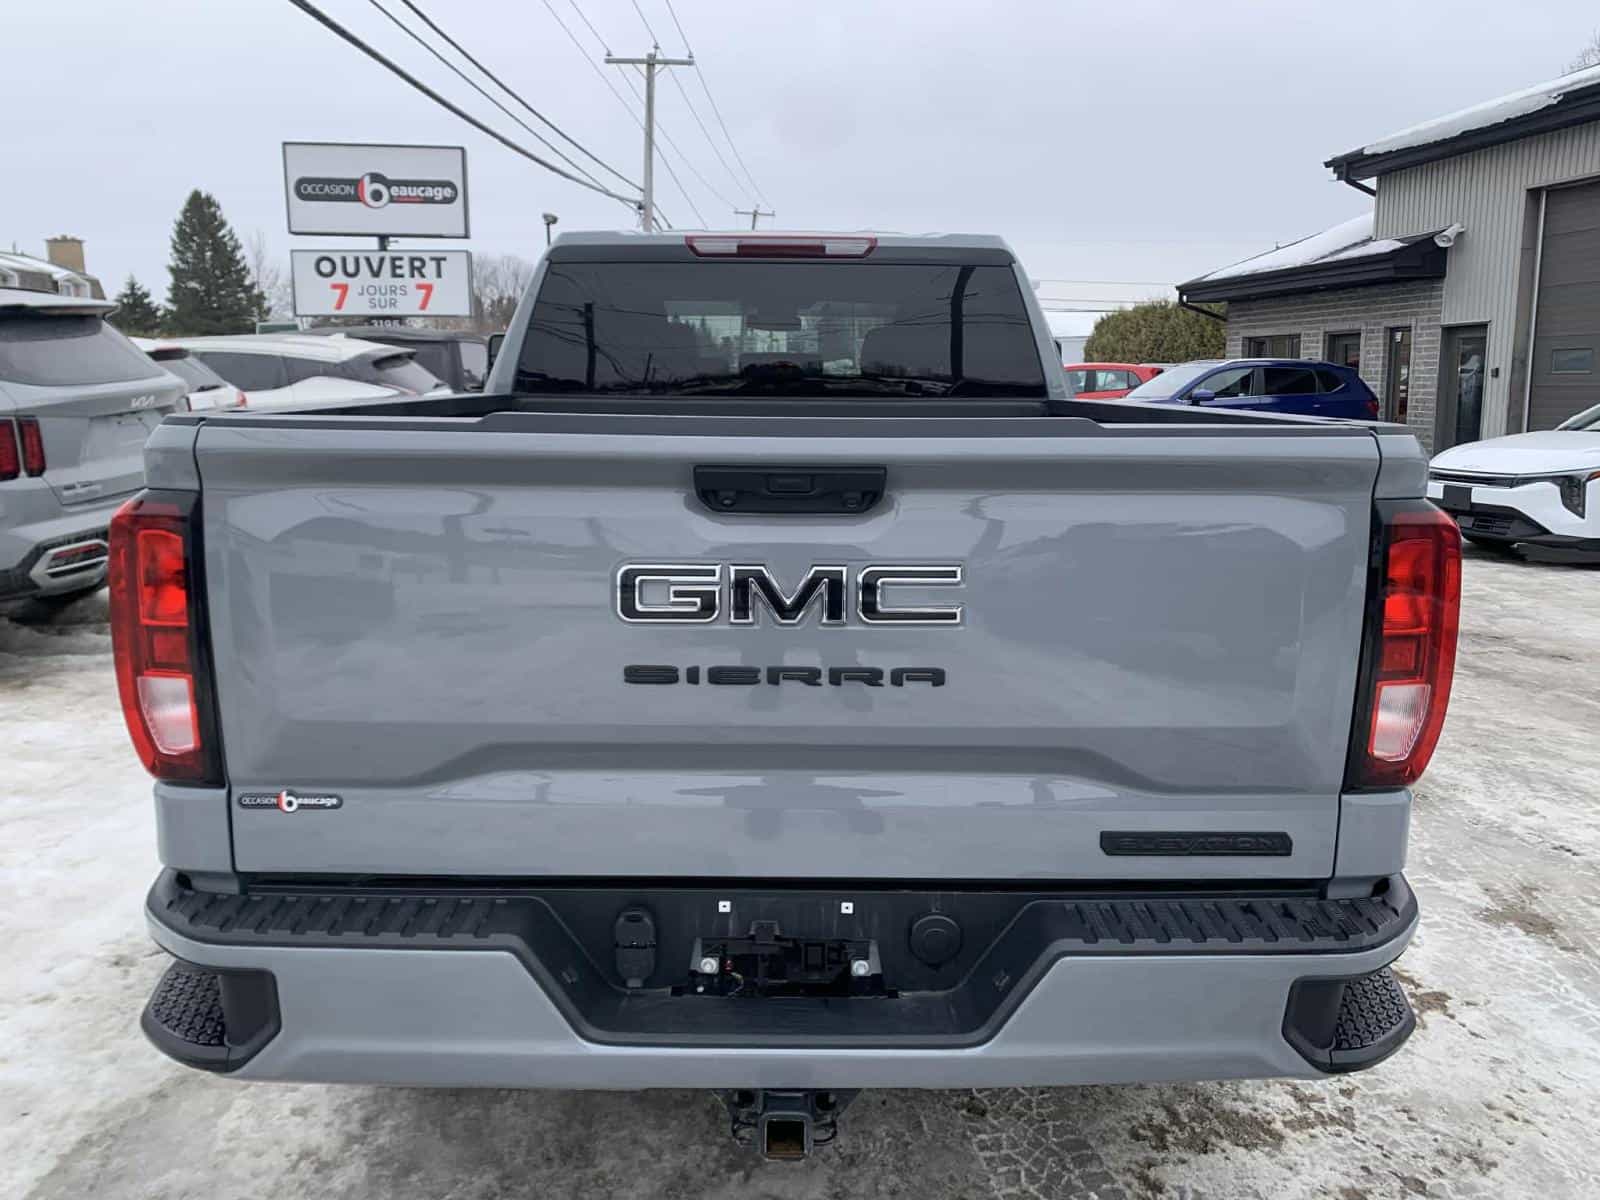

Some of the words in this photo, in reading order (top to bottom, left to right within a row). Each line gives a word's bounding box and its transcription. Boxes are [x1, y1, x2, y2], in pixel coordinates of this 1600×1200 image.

[300, 183, 355, 196] OCCASION
[314, 255, 448, 279] OUVERT
[329, 282, 350, 311] 7
[357, 284, 408, 297] JOURS
[415, 283, 434, 311] 7
[369, 297, 399, 309] SUR
[616, 564, 963, 624] GMC
[623, 665, 946, 687] SIERRA
